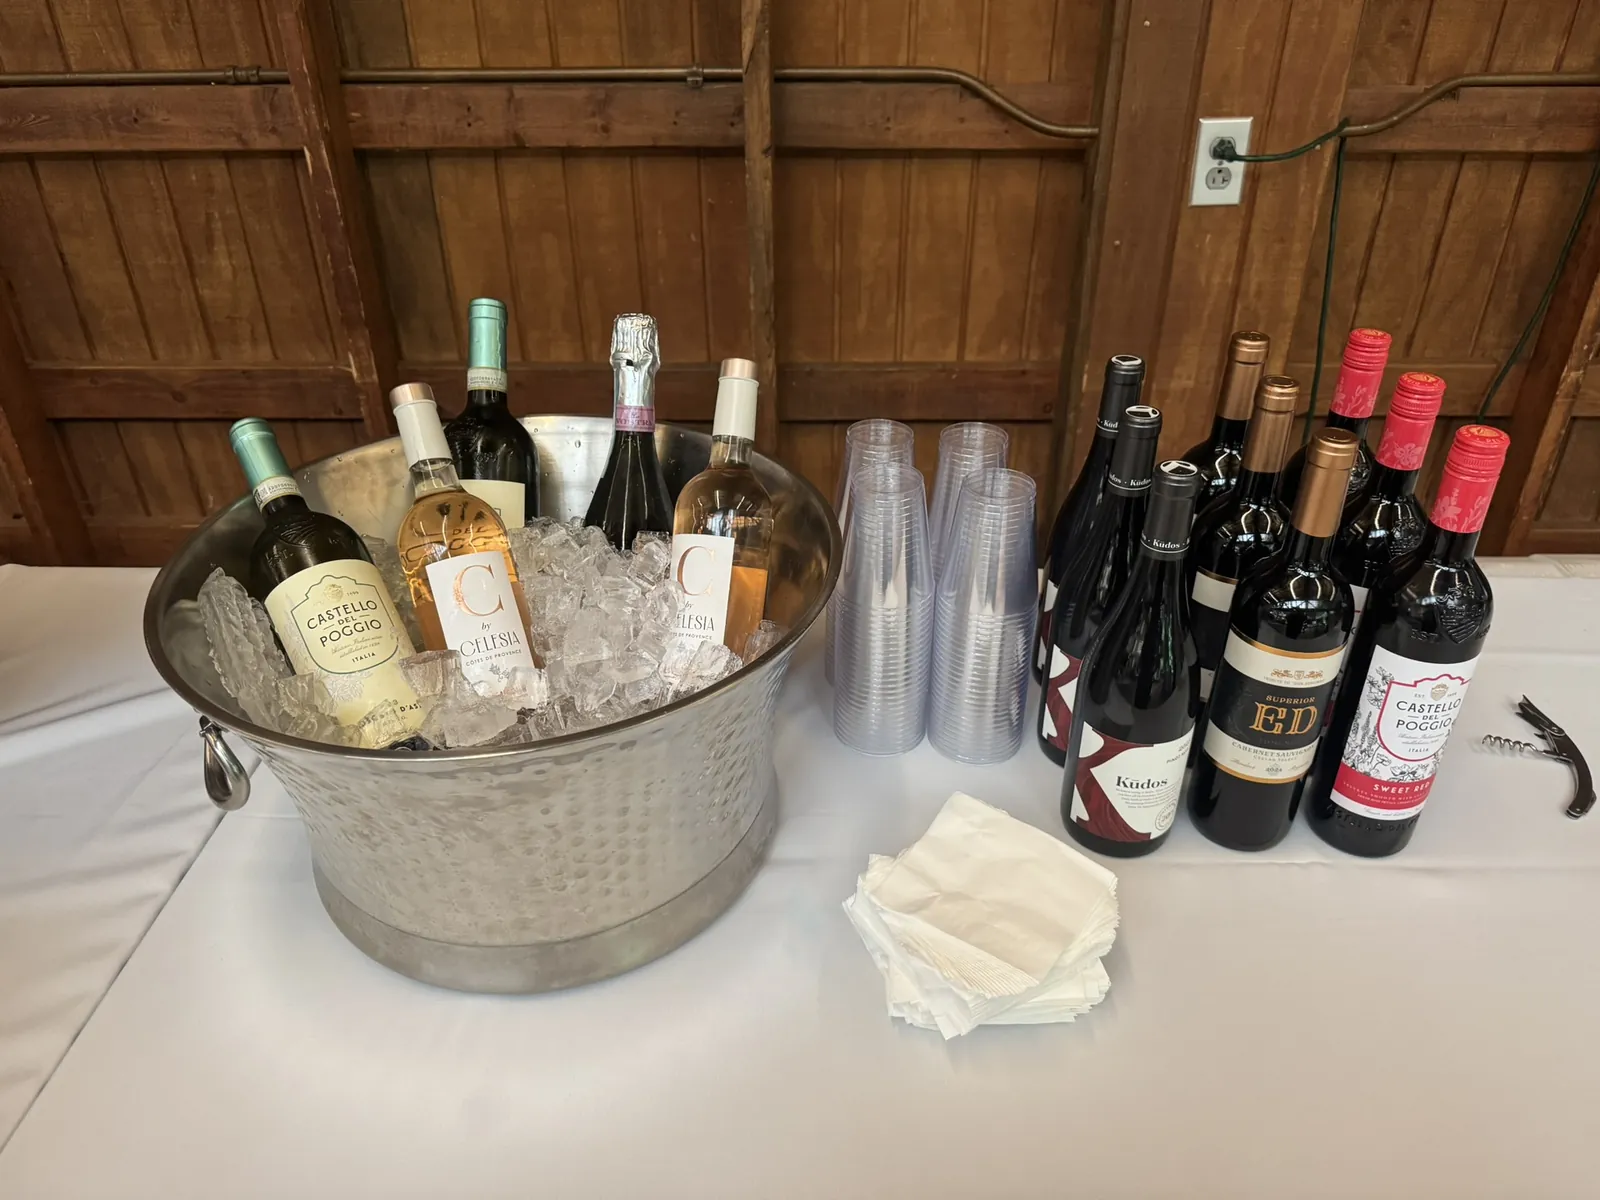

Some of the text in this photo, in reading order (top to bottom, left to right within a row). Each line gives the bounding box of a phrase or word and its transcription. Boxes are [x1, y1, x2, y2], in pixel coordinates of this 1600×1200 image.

[1103, 419, 1119, 429] Kūd
[453, 564, 505, 617] C
[684, 600, 694, 609] by
[306, 600, 378, 630] CASTELLO
[337, 615, 357, 626] DEL
[481, 622, 492, 631] by
[676, 613, 715, 632] ELESIA
[319, 619, 382, 648] POGGIO
[459, 630, 521, 658] CELESIA
[352, 652, 376, 663] ITALIA
[465, 649, 523, 668] CÔTES DE PROVENCE
[1266, 694, 1316, 705] SUPERIOR
[1396, 698, 1461, 713] CASTELLO
[400, 703, 422, 712] D'AS
[1249, 701, 1318, 735] ED
[1396, 718, 1452, 731] POGGIO
[1231, 741, 1315, 758] CABERNET SAUVIGNON
[1116, 775, 1168, 789] Kūdos
[1373, 781, 1430, 794] SWEET RED
